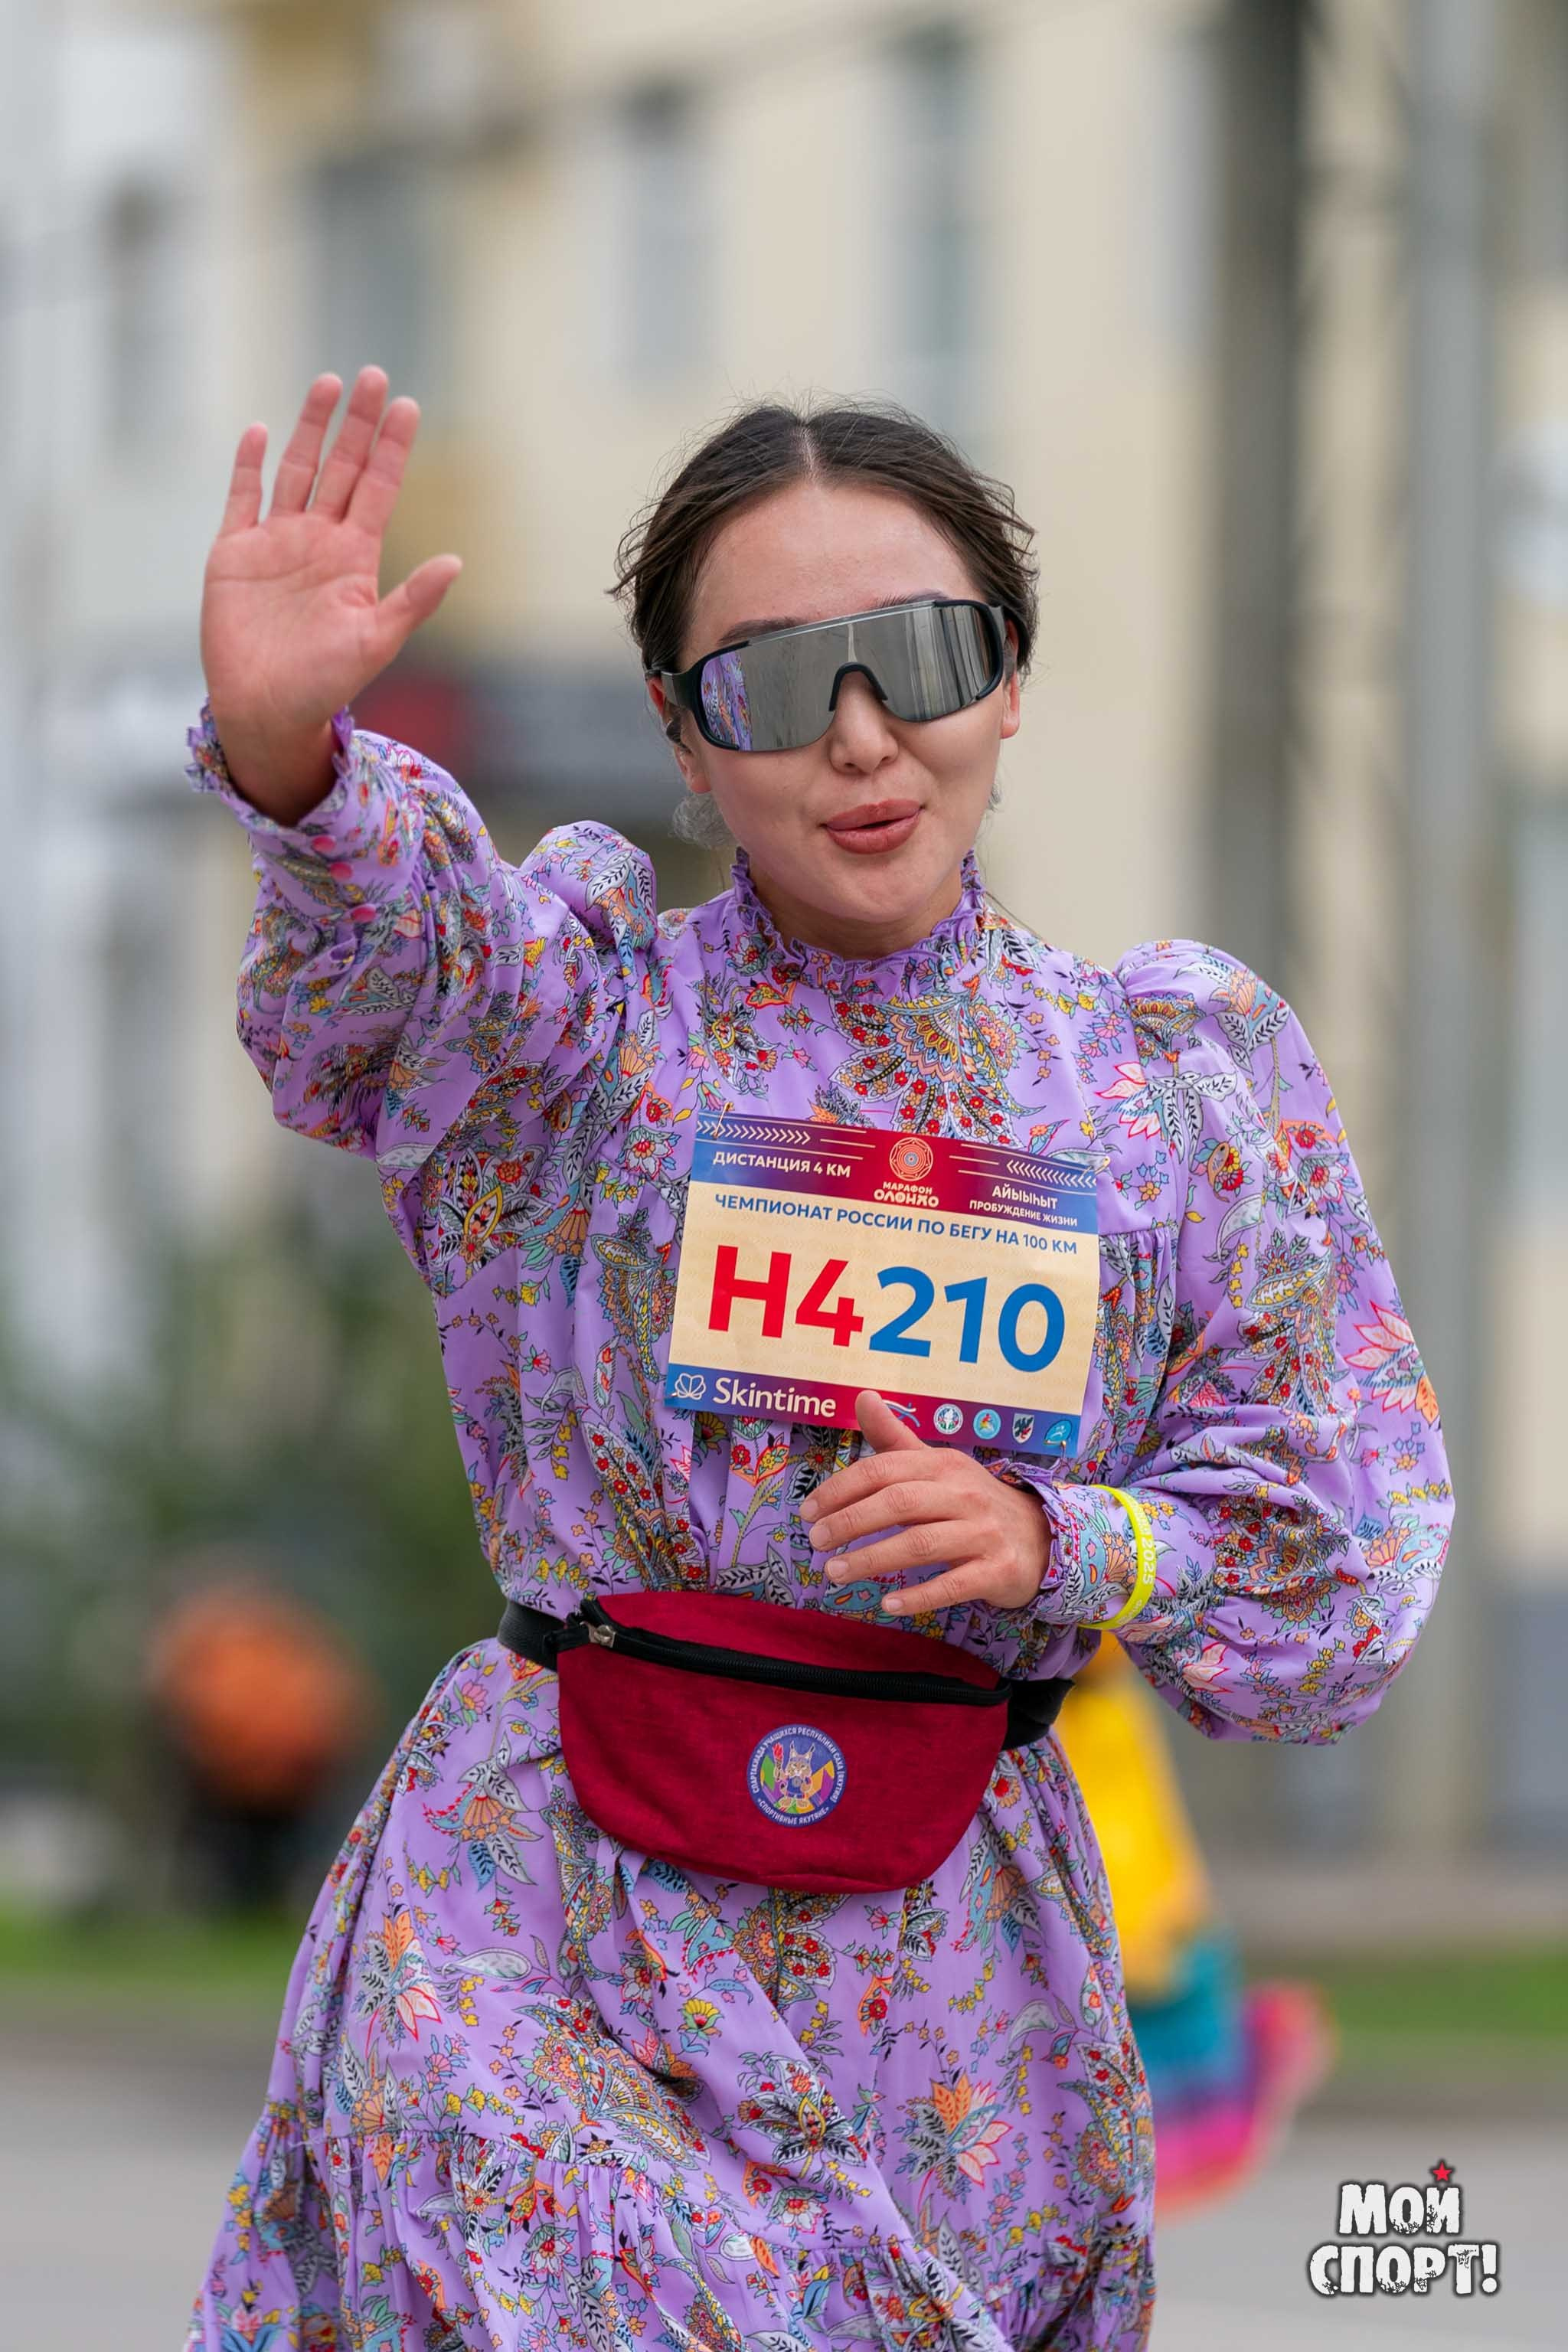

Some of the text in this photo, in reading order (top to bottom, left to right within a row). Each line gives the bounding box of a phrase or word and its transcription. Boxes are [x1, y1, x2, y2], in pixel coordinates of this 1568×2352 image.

[713, 1152, 851, 1178] ДИСТАНЦИЯ 4 КМ
[883, 1181, 933, 1194] МАРАФОН
[715, 1194, 1077, 1254] ЧЕМПИОНАТ РОССИИ ПО БЕГУ НА 100 КМ
[969, 1200, 1077, 1227] ПРОБУЖДЕНИЕ ЖИЗНИ
[708, 1244, 1065, 1373] Н4210
[713, 1377, 836, 1419] Skintime
[1142, 1537, 1155, 1584] 2025
